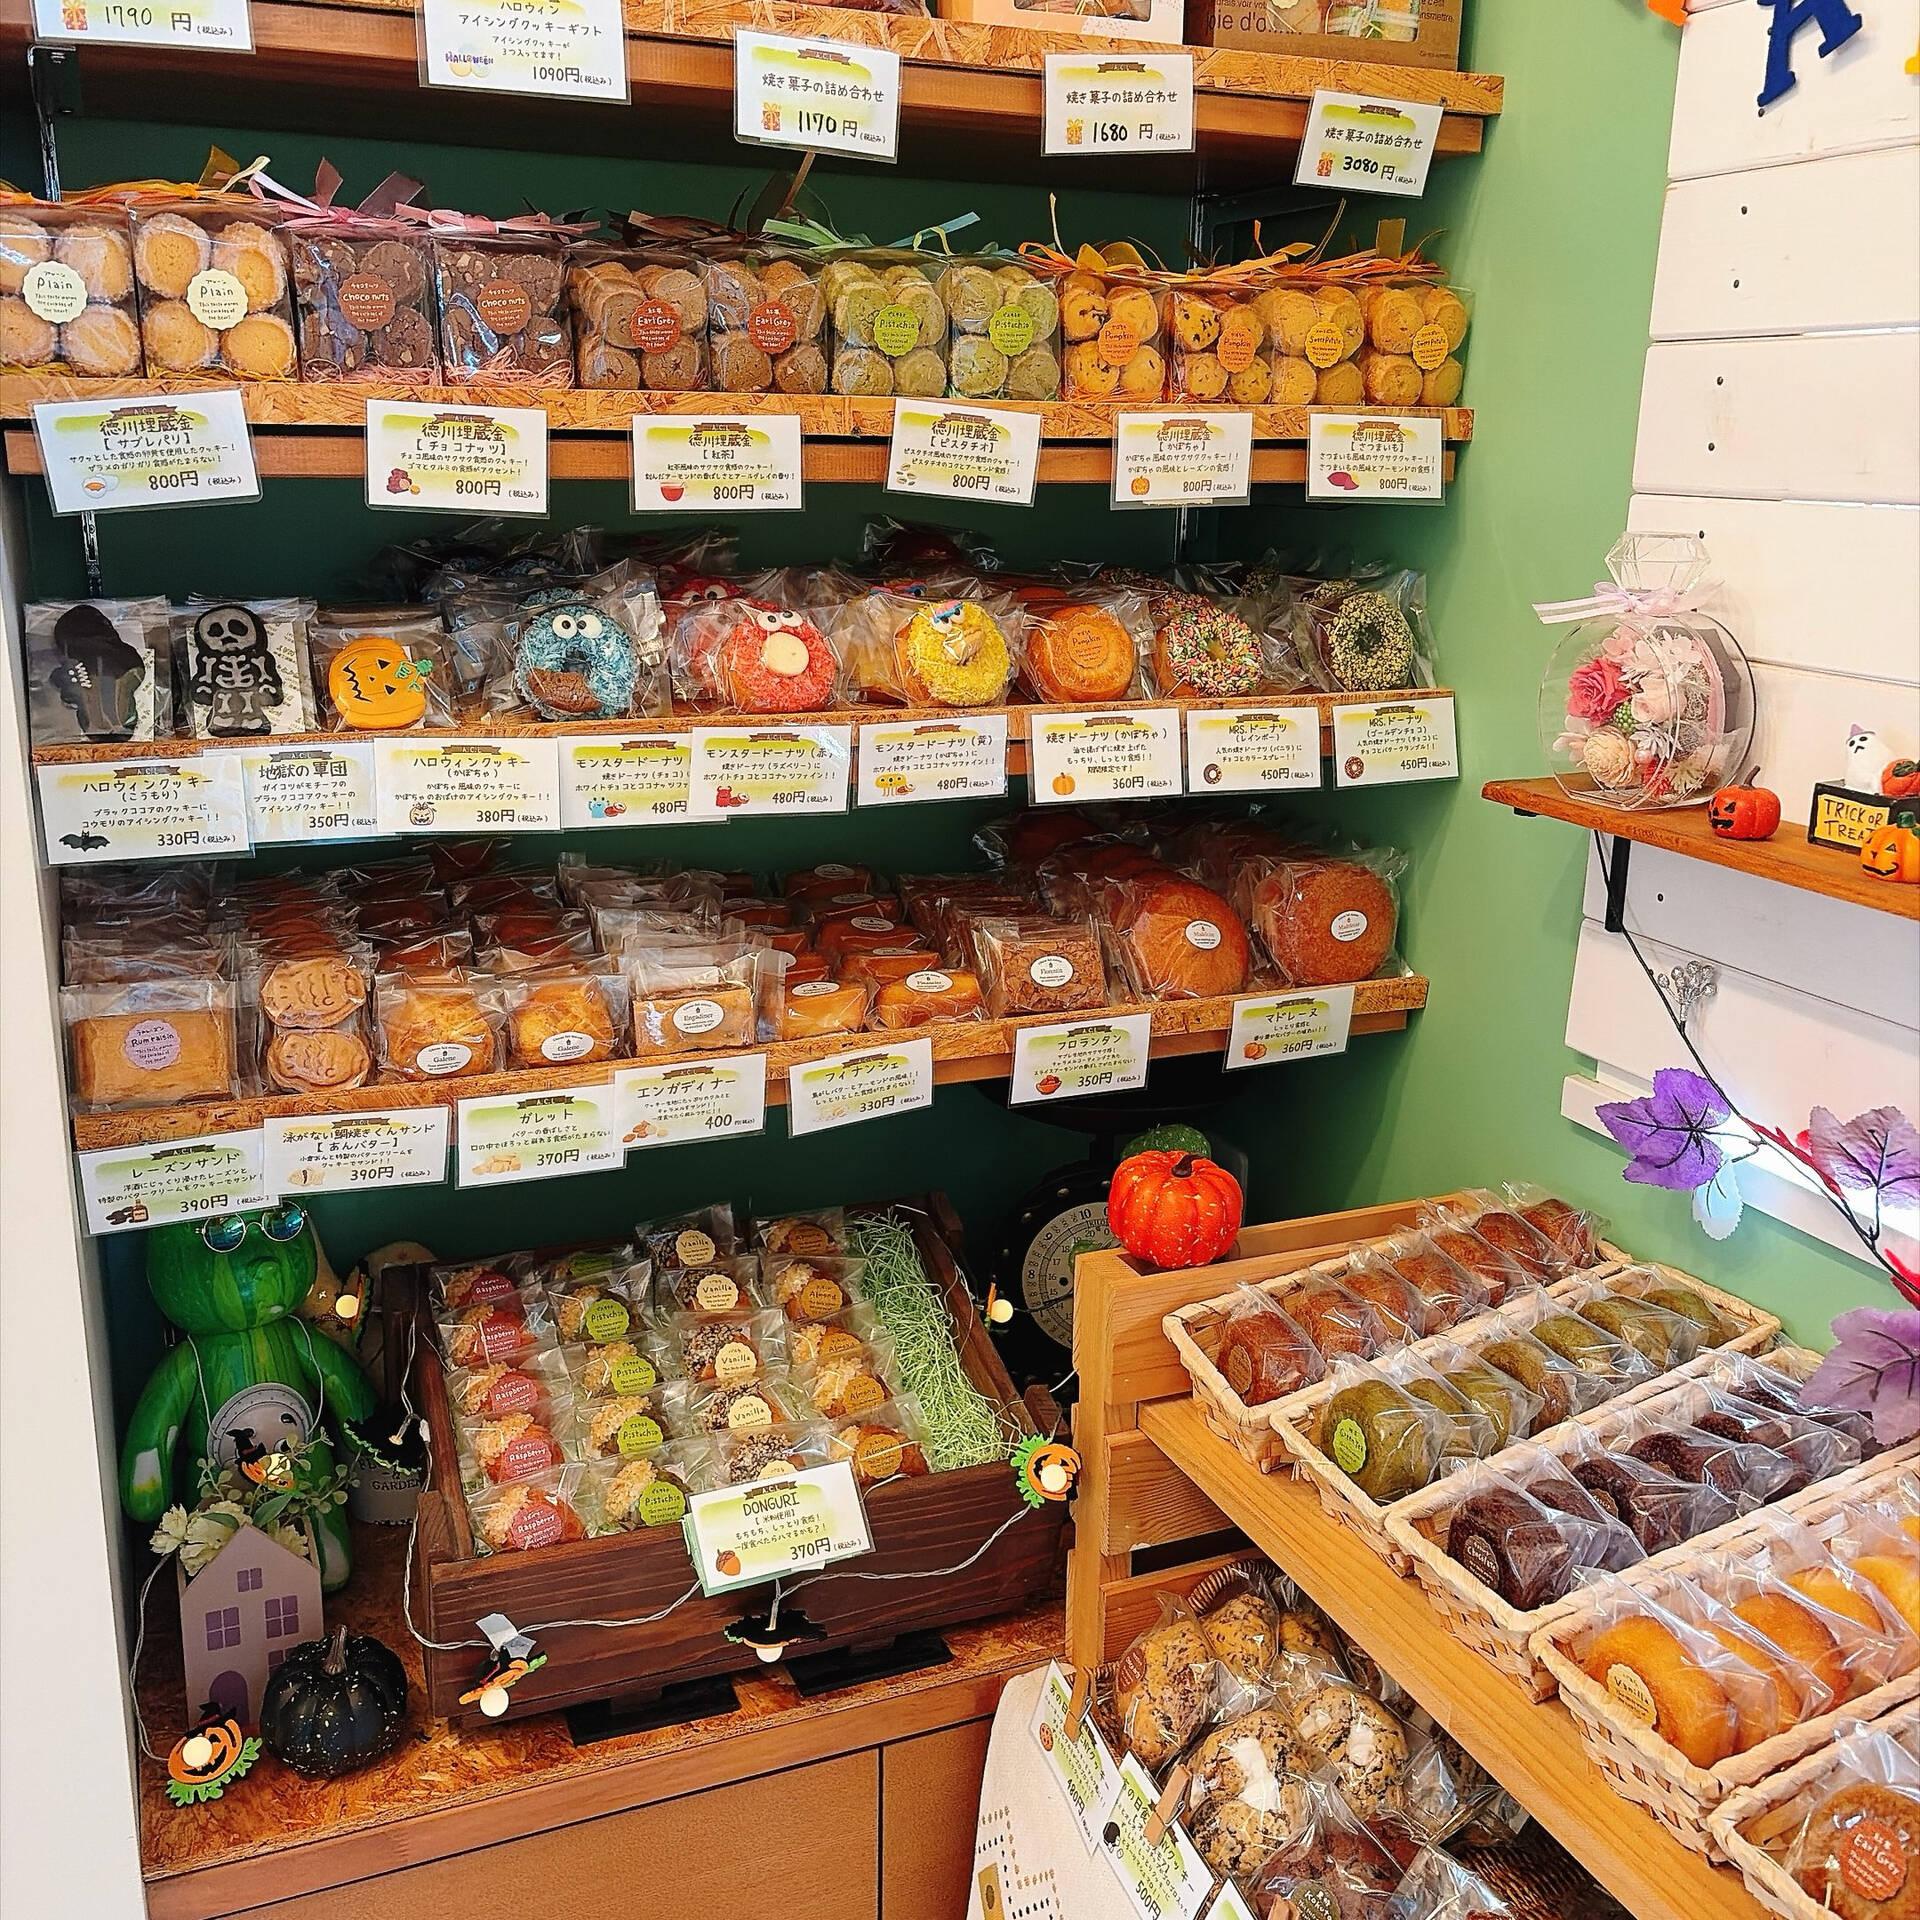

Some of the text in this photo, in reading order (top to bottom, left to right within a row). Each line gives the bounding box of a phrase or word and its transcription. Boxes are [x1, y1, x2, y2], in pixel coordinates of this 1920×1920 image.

[500, 2, 559, 15] ハロウィン
[105, 5, 191, 32] 1790 円
[459, 14, 602, 37] アイシングクッキーギフト
[533, 66, 580, 84] 1090円
[762, 73, 885, 102] 焼き菓子の詰め合わせ
[1066, 90, 1178, 104] 焼き菓子の詰め合わせ
[1093, 122, 1153, 143] 1680 円
[1325, 127, 1423, 149] 焼き菓子の詰め合わせ
[37, 277, 73, 289] Plain
[200, 285, 233, 297] Plain
[879, 319, 915, 330] Pistachio
[995, 320, 1029, 329] Pistachio
[1105, 330, 1133, 340] Pumpkin
[1223, 338, 1251, 348] Pumpkin
[99, 415, 195, 435] 徳川埋蔵金
[421, 423, 507, 442] 徳川埋蔵金
[931, 420, 1001, 442] 徳川埋蔵金
[688, 434, 753, 447] 徳川埋蔵金
[1156, 428, 1213, 442] 徳川埋蔵金
[1352, 430, 1406, 443] 徳川埋蔵金
[149, 470, 198, 490] 800円
[455, 479, 501, 496] 800円
[952, 474, 990, 491] 800円
[1183, 479, 1212, 493] 800円
[1379, 478, 1408, 490] 800円
[713, 484, 754, 500] 800円
[1388, 715, 1422, 725] ドーナツ
[1250, 724, 1287, 733] ドーナツ
[413, 757, 531, 768] ハロウィンクッキー
[576, 756, 683, 768] モンスタードーナツ
[1401, 757, 1427, 770] 450円
[258, 760, 348, 780] 地獄の軍団
[1261, 767, 1290, 780] 450円
[83, 776, 213, 793] ハロウィンクッキー
[263, 780, 347, 791] ガイコツがモチーフの
[937, 777, 968, 790] 480円
[1112, 776, 1144, 789] 360円
[253, 791, 356, 803] ブラックココアクッキーの
[772, 790, 805, 804] 480円
[93, 803, 208, 817] ブラックココアのクッキーに
[652, 800, 687, 814] 480円
[1824, 798, 1865, 823] TRICK
[309, 813, 349, 828] 350円
[476, 809, 515, 823] 380円
[157, 831, 199, 847] 330円
[1266, 1008, 1318, 1023] マドレーヌ
[131, 1033, 174, 1048] Rum raisin
[1057, 1035, 1121, 1050] フロランタン
[1282, 1039, 1313, 1054] 360円
[825, 1061, 899, 1082] フィナンシェ
[1077, 1071, 1112, 1087] 350円
[637, 1077, 736, 1099] エンガディナー
[859, 1095, 895, 1113] 330円
[519, 1109, 574, 1124] ガレット
[704, 1114, 733, 1129] 400
[132, 1152, 240, 1178] レーズンサンド
[537, 1149, 579, 1166] 370円
[350, 1165, 394, 1181] 390円
[180, 1194, 228, 1213] 390円
[1080, 1208, 1092, 1220] 10
[681, 1239, 709, 1248] Vanilla
[475, 1283, 509, 1294] Raspberry
[702, 1284, 732, 1293] Vanilla
[809, 1290, 837, 1299] Almond
[591, 1309, 625, 1323] Pistachio
[721, 1354, 751, 1365] Vanilla
[616, 1364, 651, 1377] Pistachio
[495, 1383, 532, 1401] Raspberry
[849, 1388, 877, 1400] Almond
[734, 1408, 765, 1421] Vanilla
[623, 1427, 659, 1440] Pistachio
[509, 1447, 546, 1462] Raspberry
[644, 1494, 681, 1507] Pistachio
[742, 1491, 800, 1516] DONGURI
[518, 1513, 556, 1533] Raspberry
[790, 1537, 831, 1560] 370円
[1614, 1676, 1649, 1705] Vanilla
[1067, 1778, 1084, 1816] 480円
[1135, 1880, 1162, 1920] 500円
